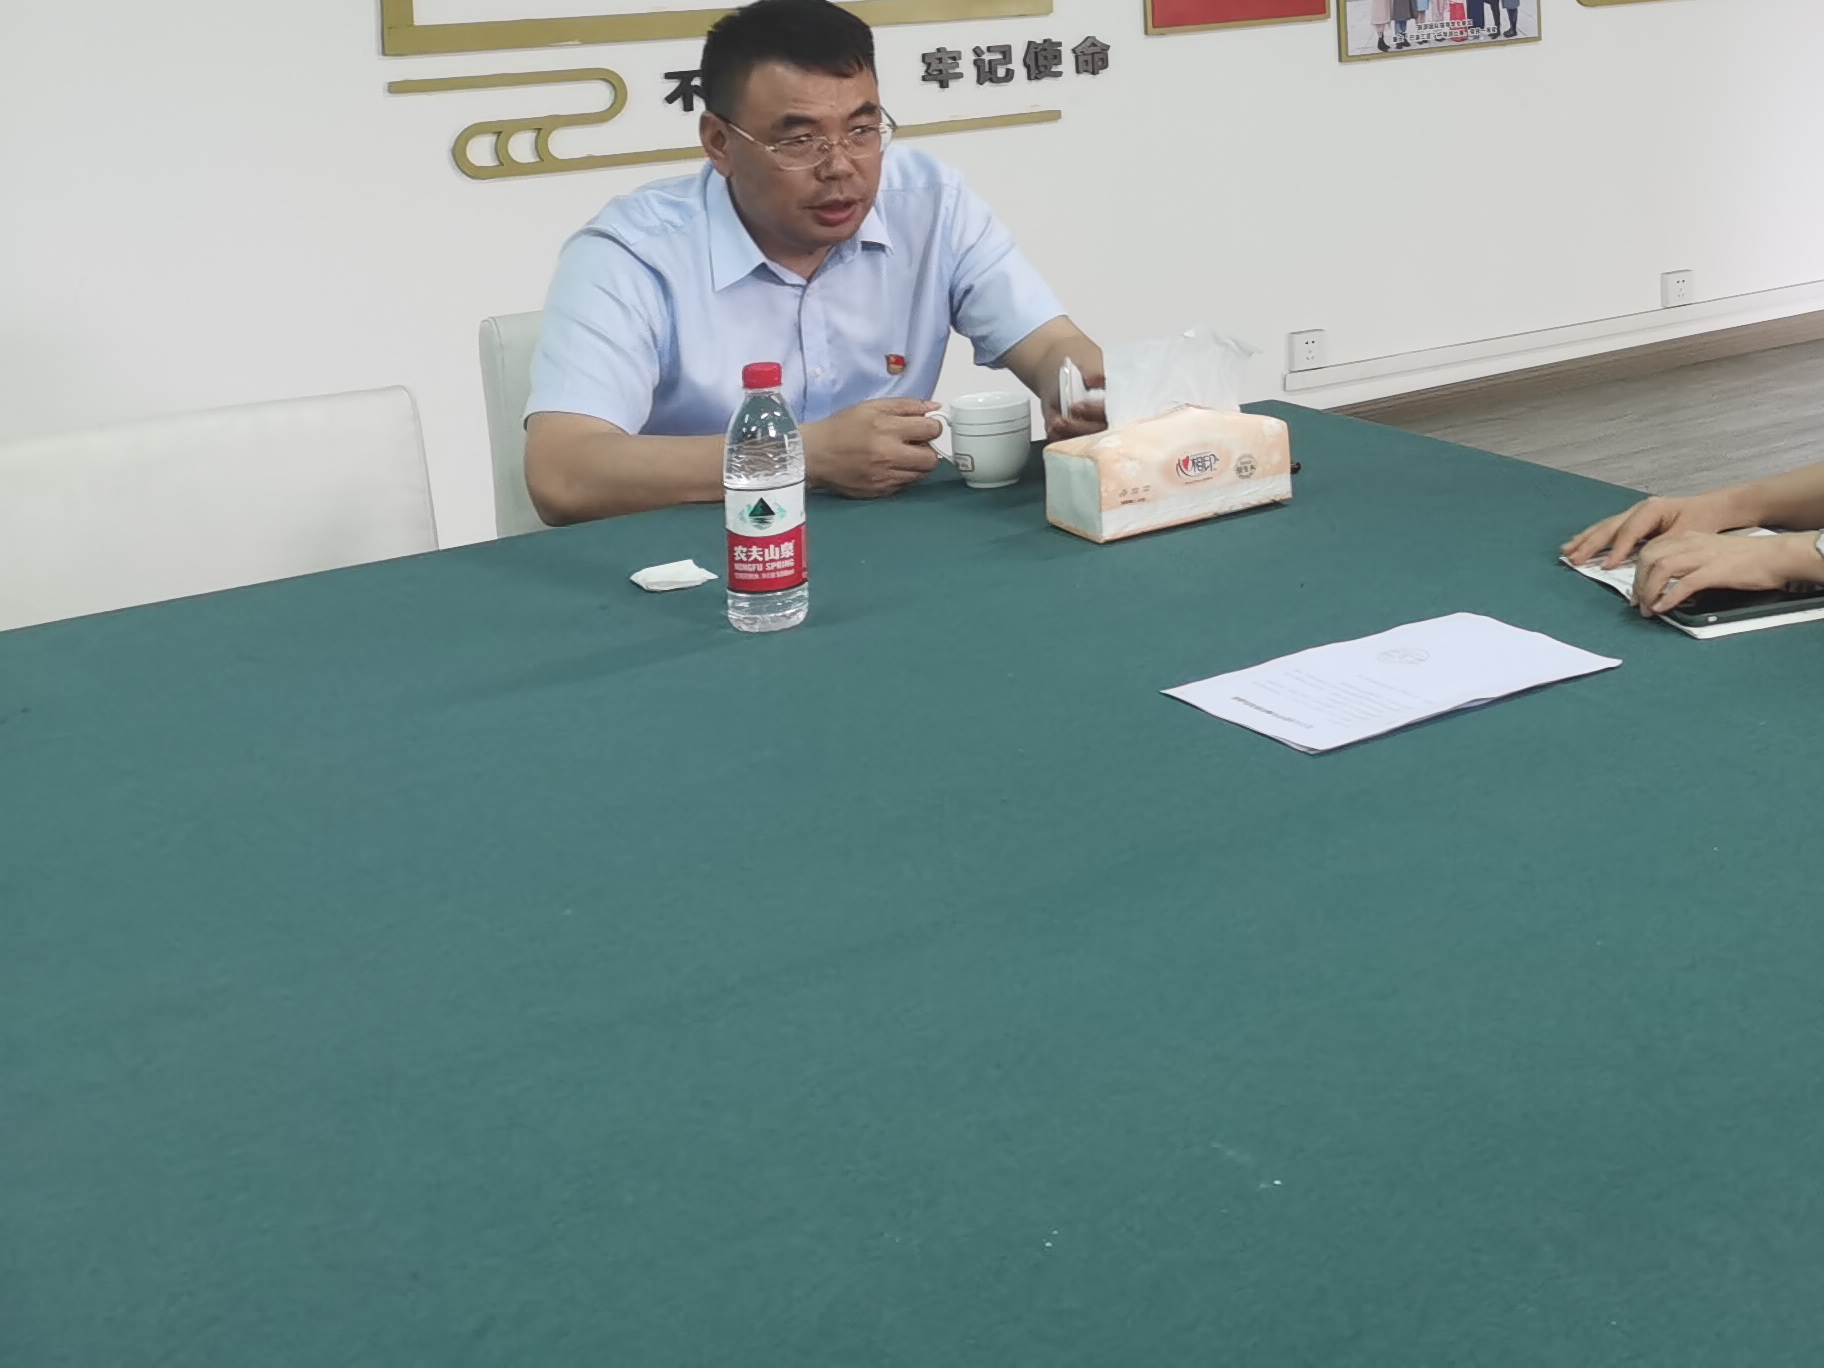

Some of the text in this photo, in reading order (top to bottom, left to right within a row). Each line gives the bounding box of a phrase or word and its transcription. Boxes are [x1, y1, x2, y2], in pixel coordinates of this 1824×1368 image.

[921, 34, 1113, 88] 牢记使命
[733, 541, 795, 562] 农夫山泉
